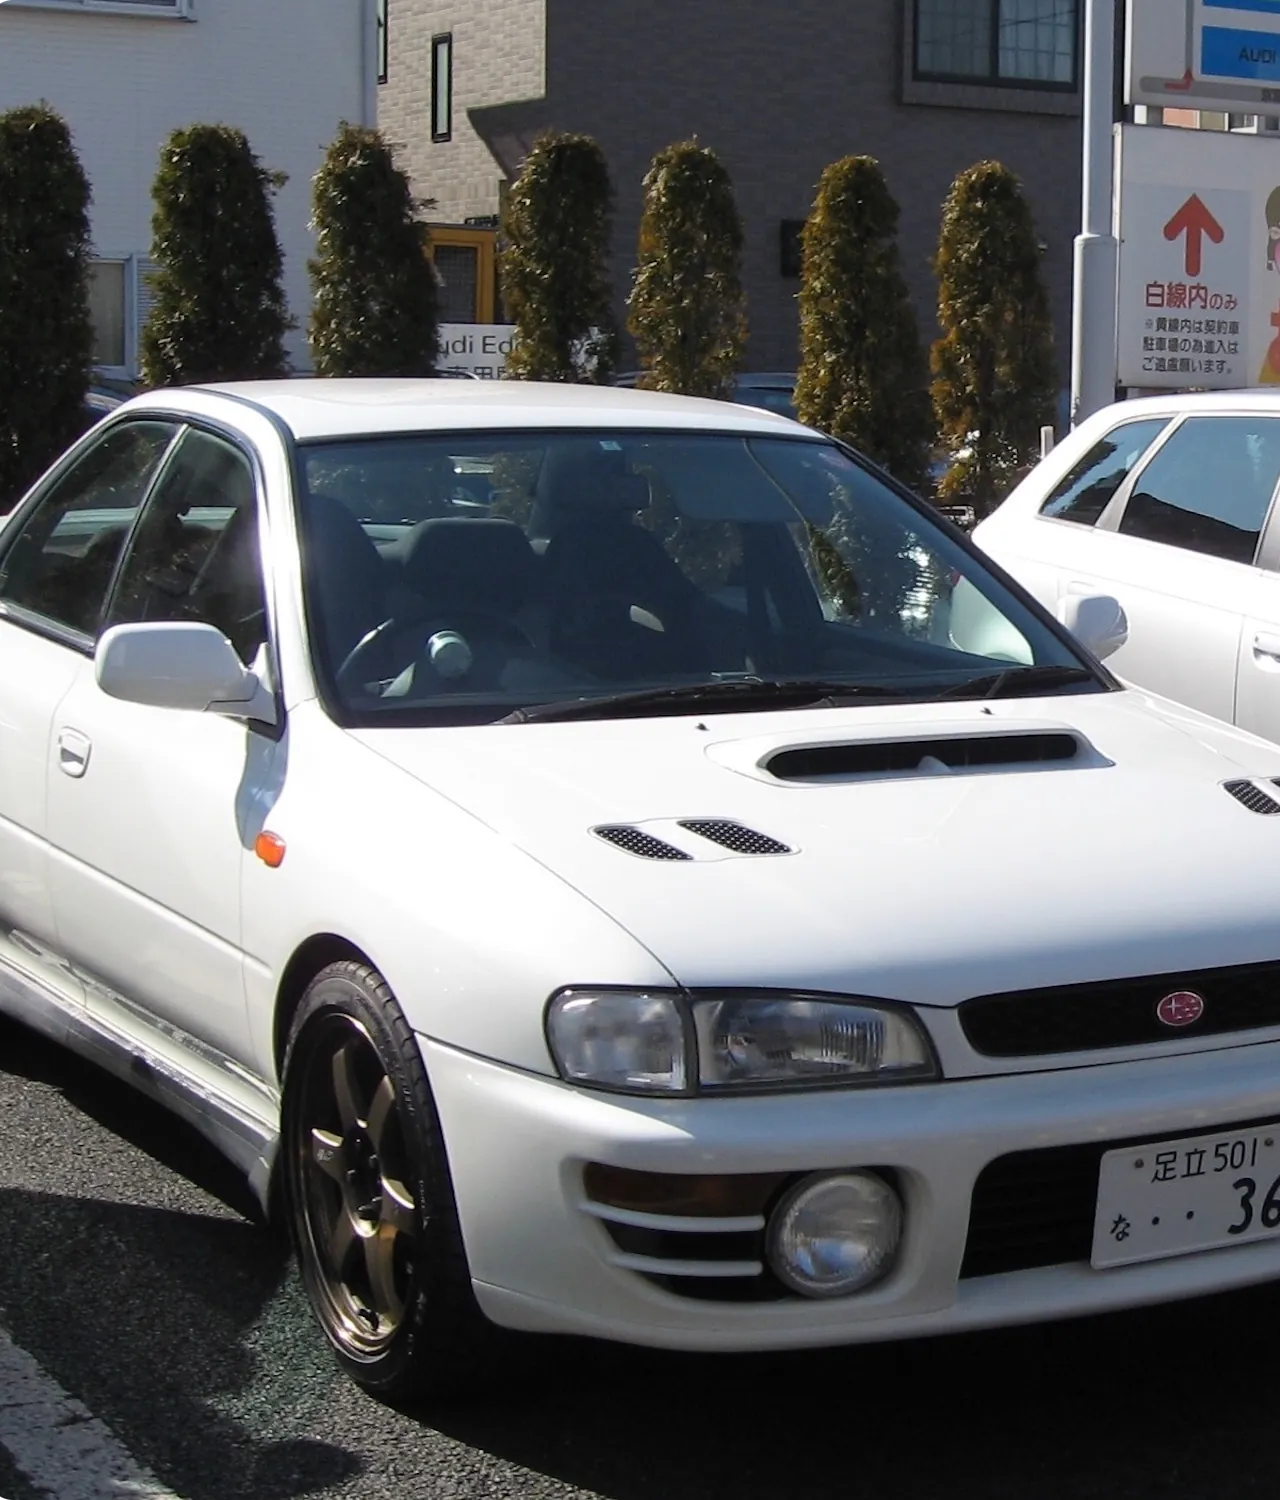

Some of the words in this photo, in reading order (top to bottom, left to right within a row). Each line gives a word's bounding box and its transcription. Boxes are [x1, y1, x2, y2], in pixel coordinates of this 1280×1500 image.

[1238, 45, 1276, 64] AUDI
[1145, 280, 1238, 311] 白線内のみ
[439, 335, 473, 355] udi
[1110, 1213, 1131, 1242] な
